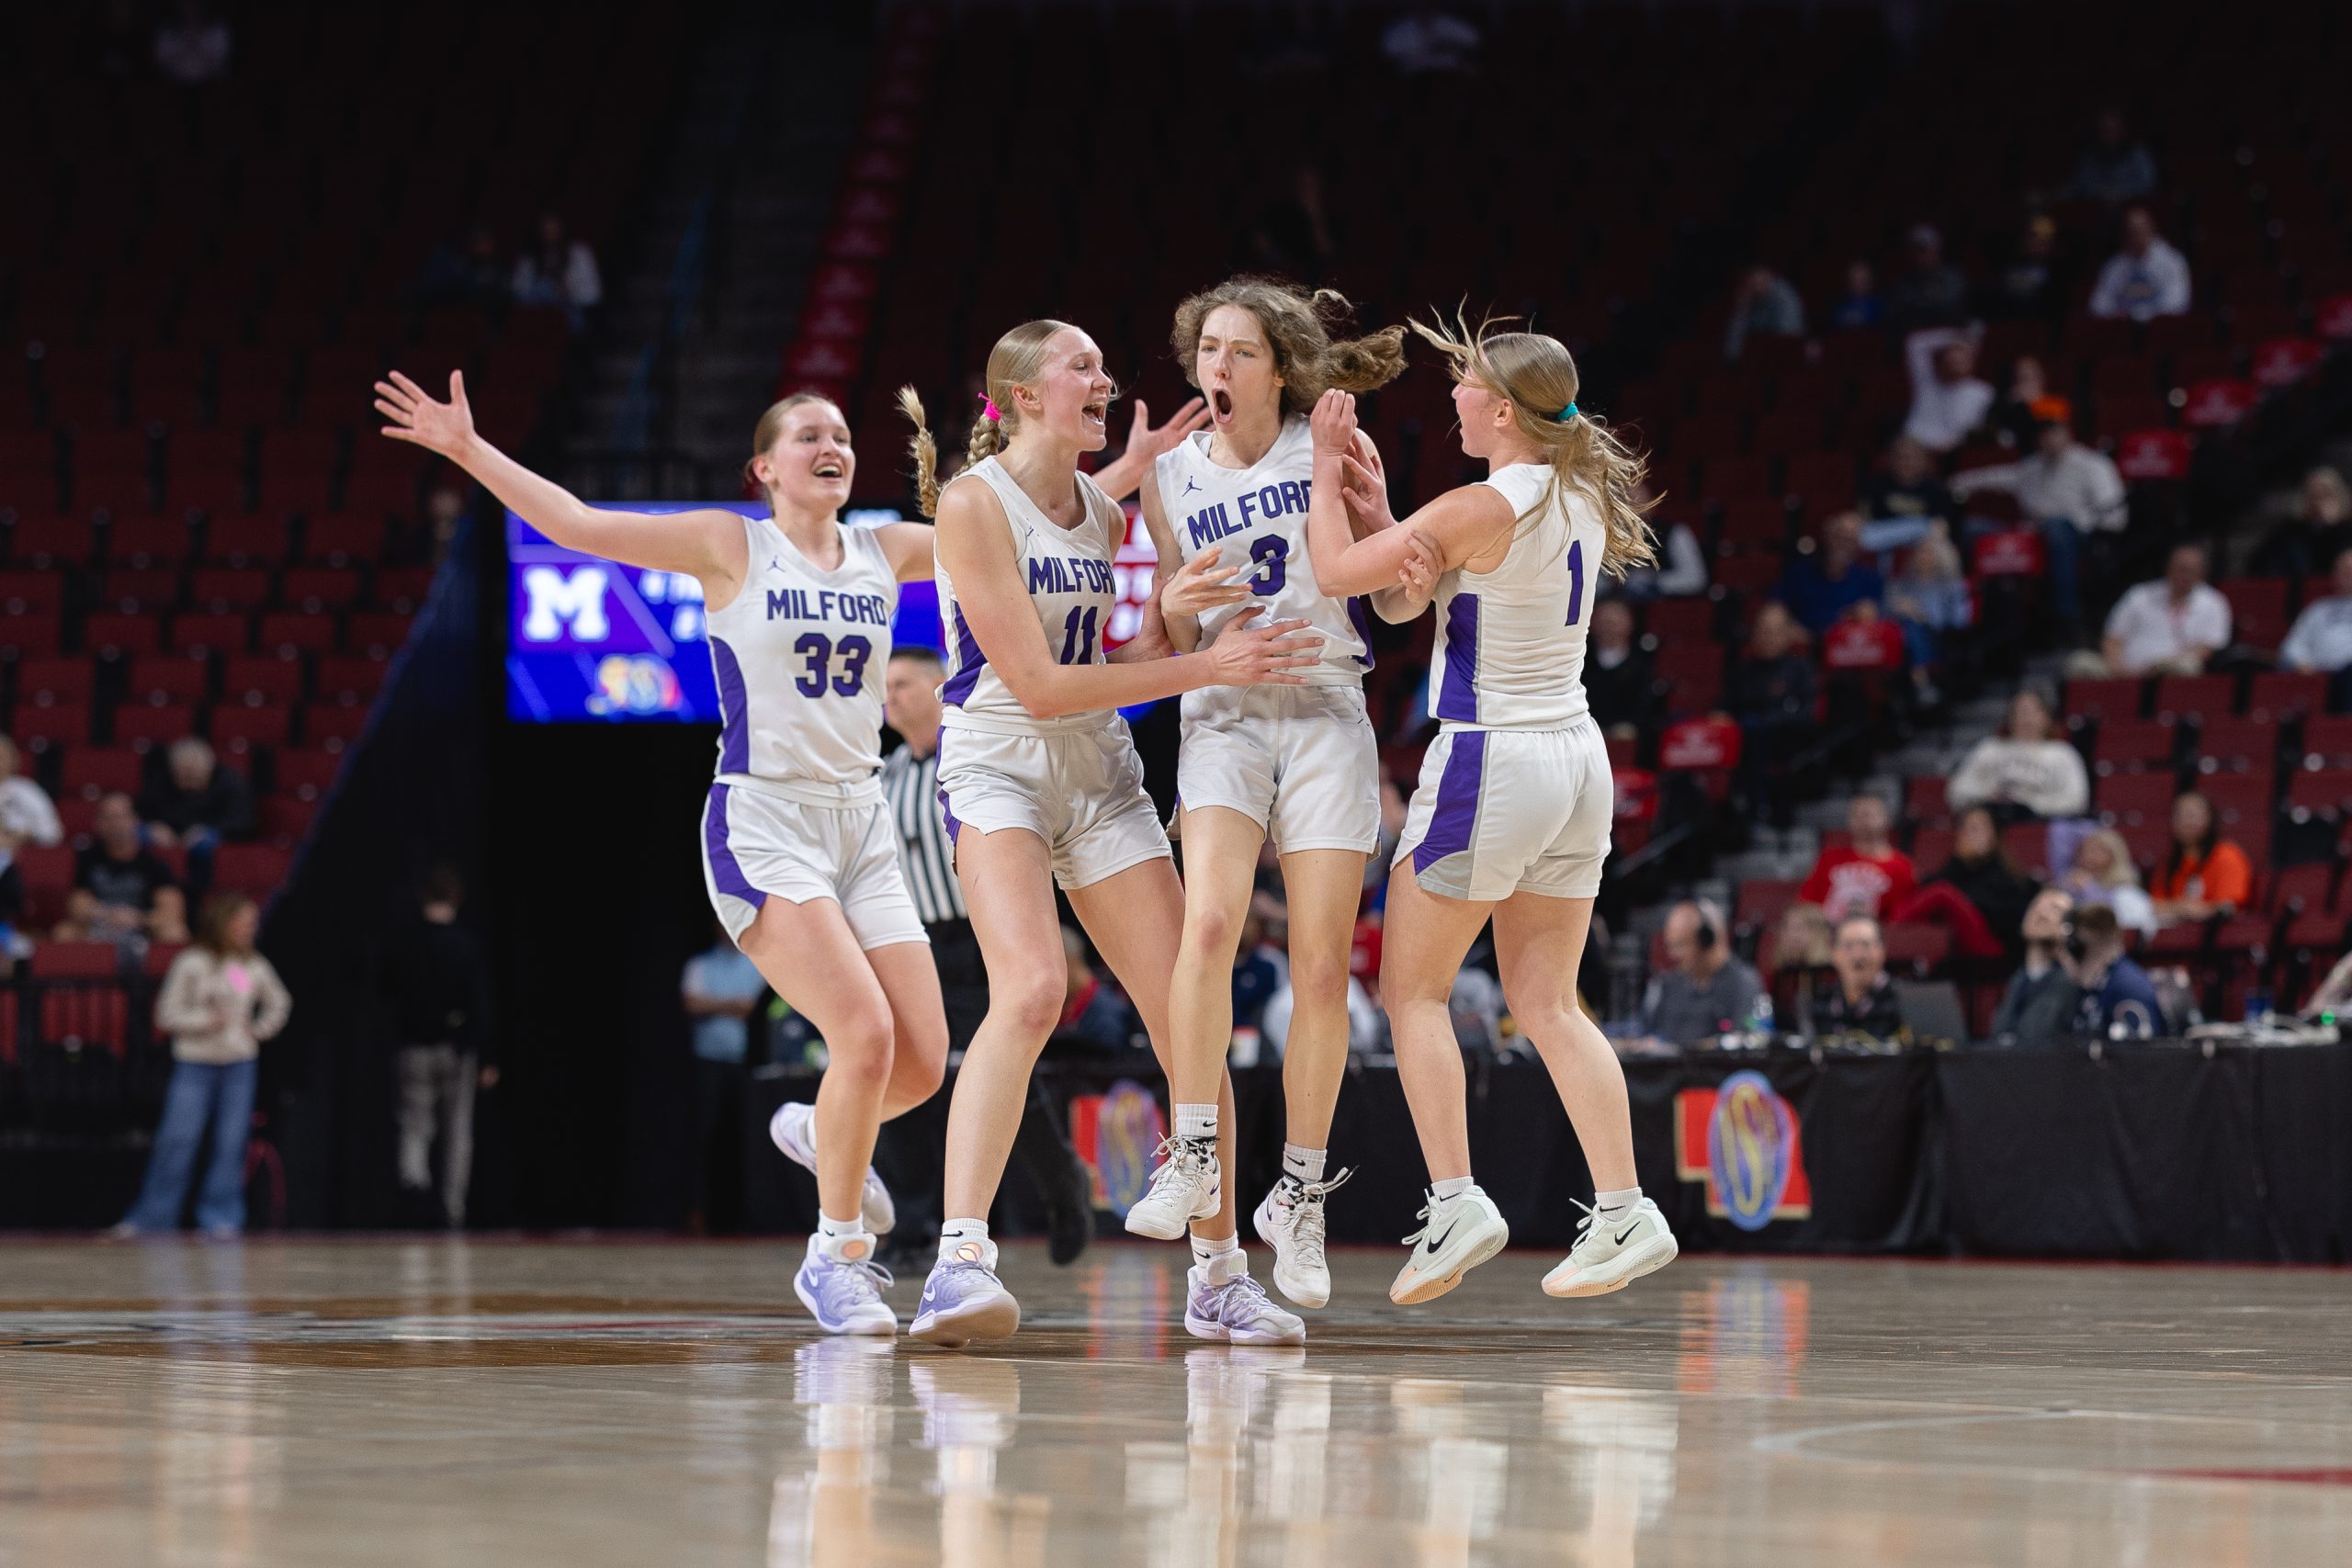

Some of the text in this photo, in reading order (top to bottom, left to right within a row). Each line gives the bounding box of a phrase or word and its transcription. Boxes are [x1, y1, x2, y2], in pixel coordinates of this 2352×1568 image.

[1249, 533, 1290, 597] 3
[1565, 539, 1584, 626] 1
[523, 565, 609, 642] M
[766, 589, 888, 626] MILFORD
[1059, 605, 1099, 665] 11
[794, 632, 872, 698] 33
